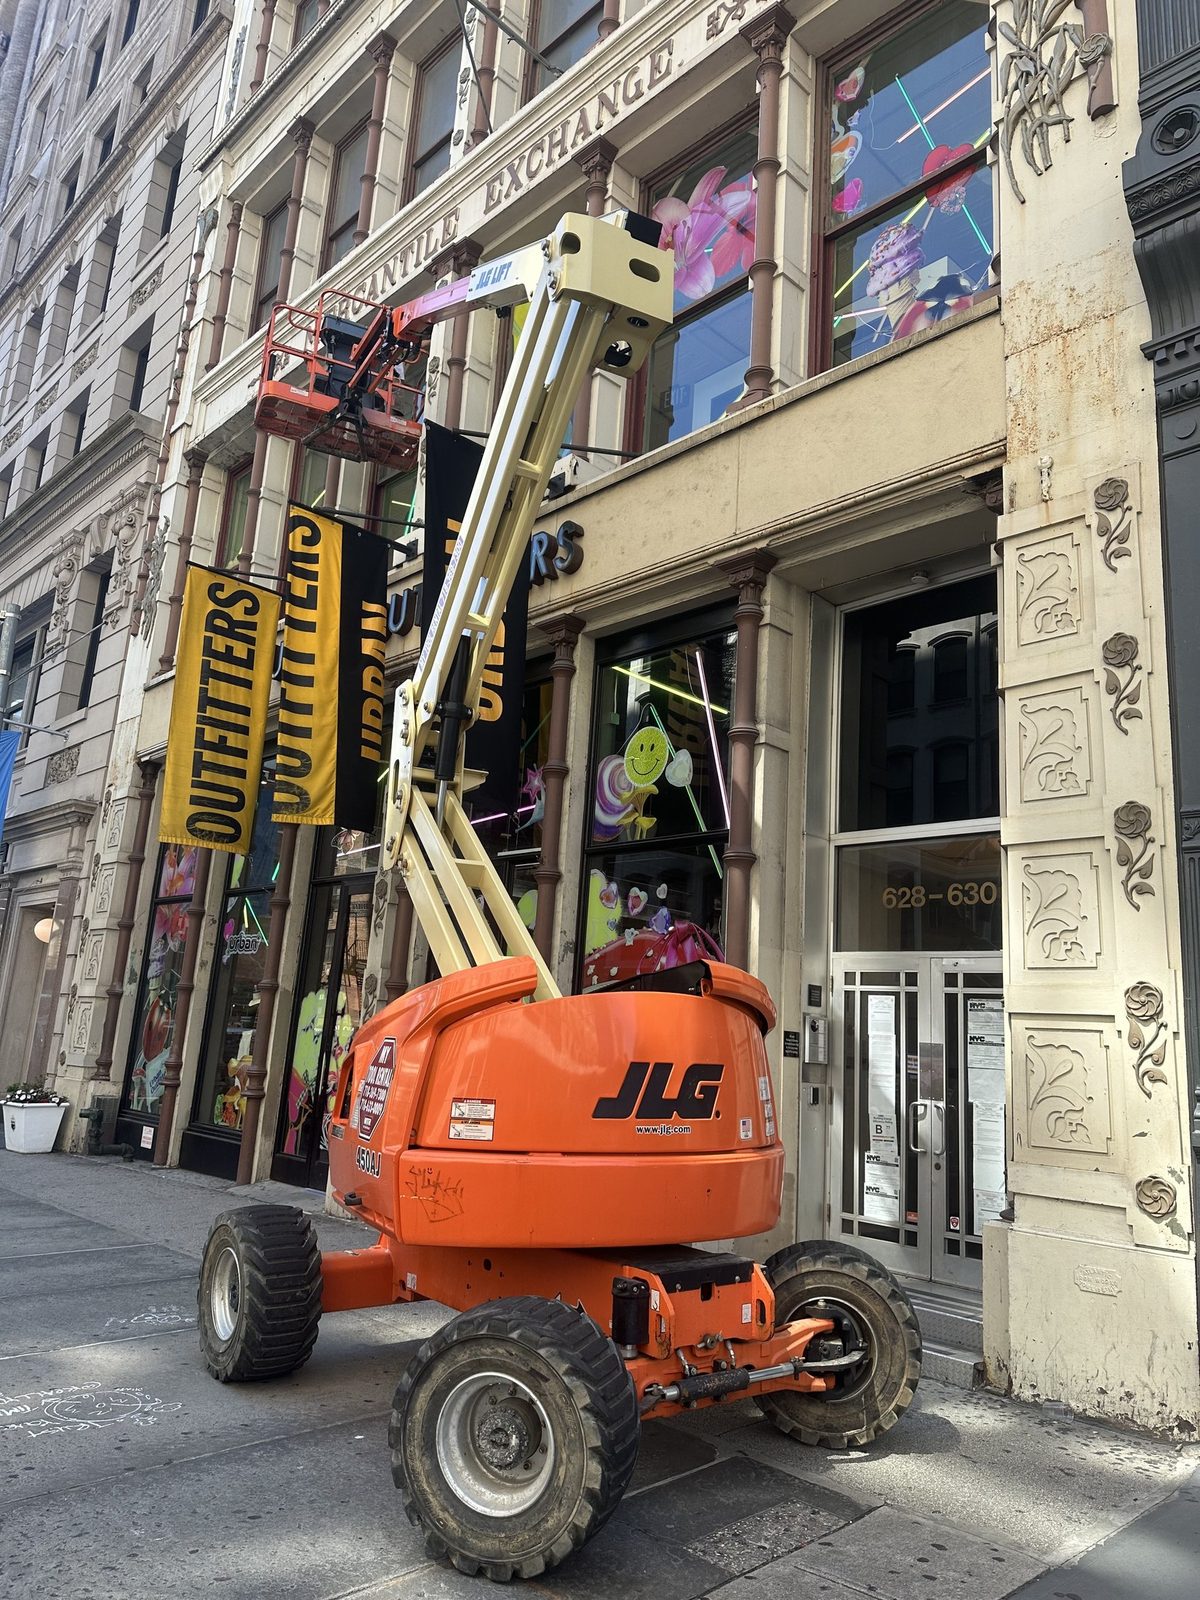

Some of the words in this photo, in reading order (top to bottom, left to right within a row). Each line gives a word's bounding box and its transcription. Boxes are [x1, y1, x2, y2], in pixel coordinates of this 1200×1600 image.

[332, 207, 460, 319] RCANTILE
[484, 38, 684, 215] EXCHANGE.
[475, 267, 493, 290] JLG
[491, 261, 513, 285] LIFT
[185, 582, 260, 844] OUTFITTERS
[636, 1125, 691, 1135] www.jlg.com
[875, 1124, 883, 1134] B
[357, 1145, 381, 1177] 450AJ
